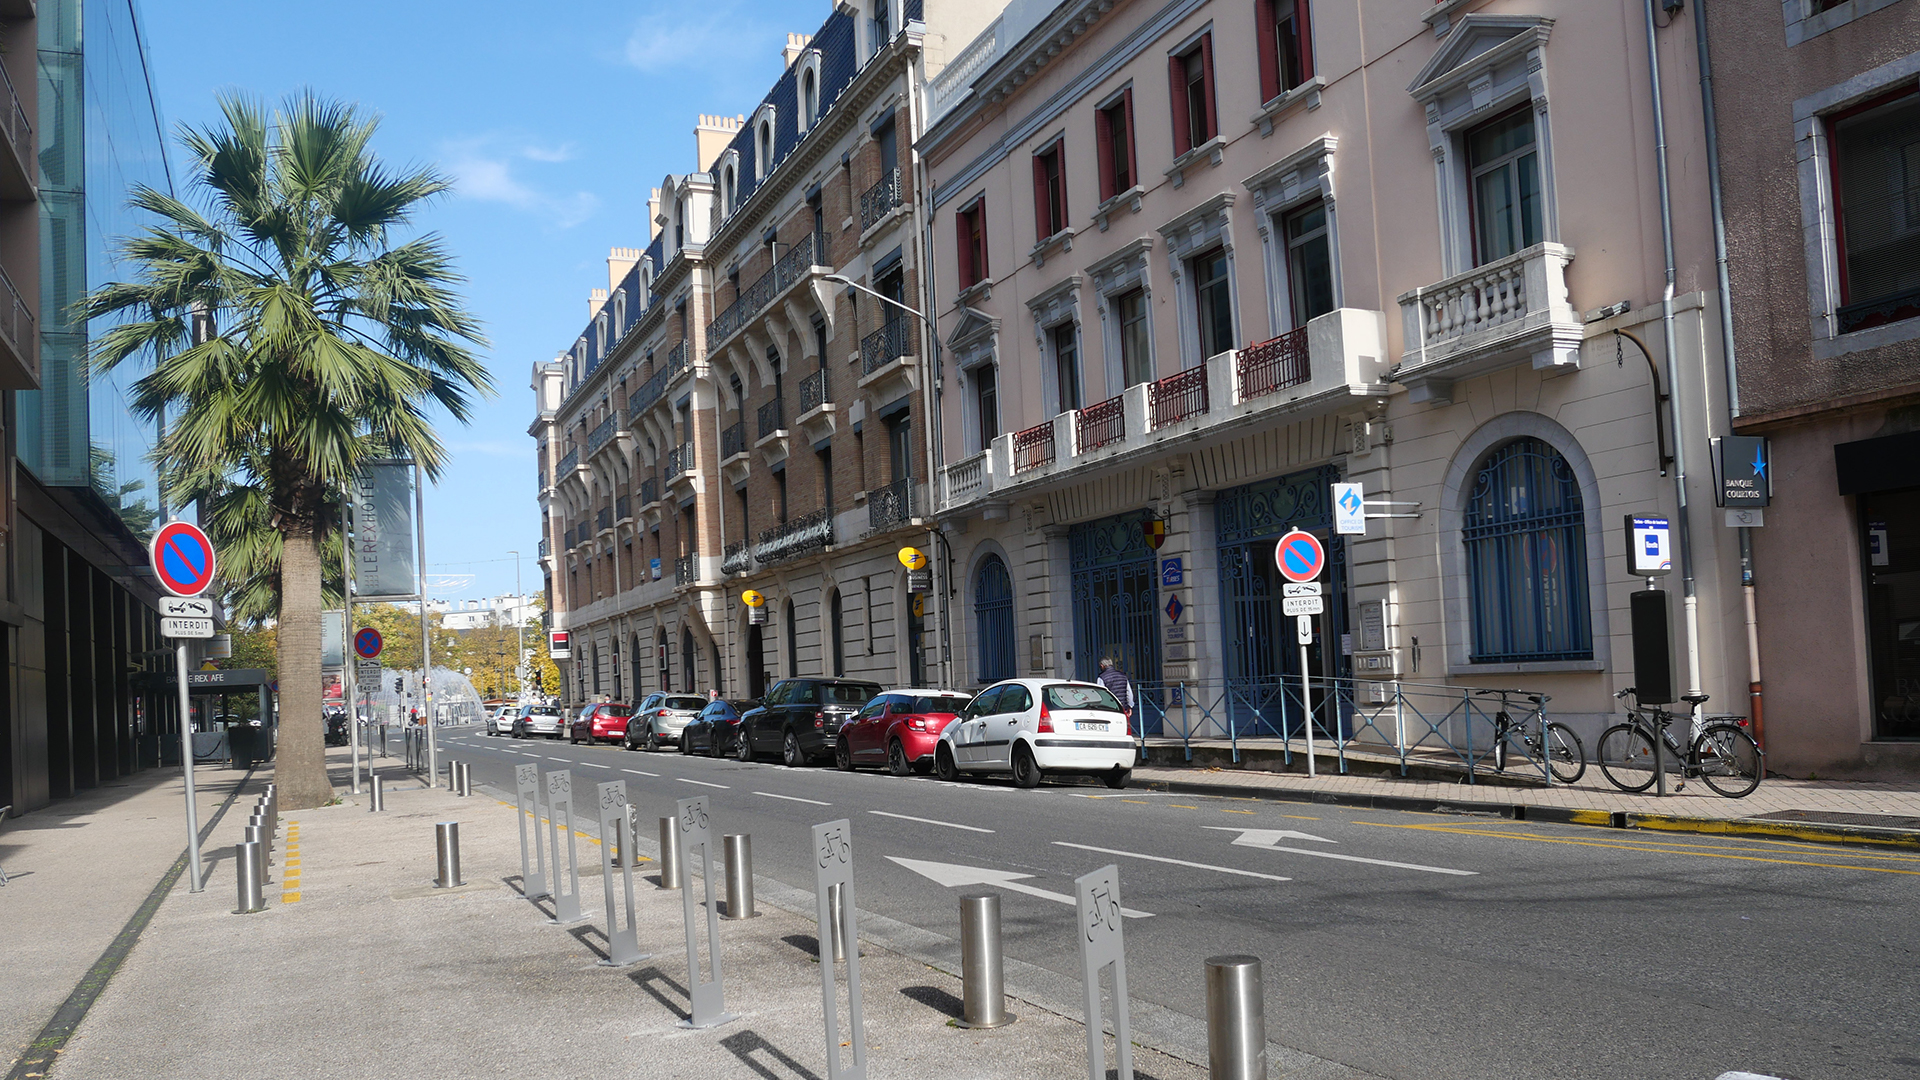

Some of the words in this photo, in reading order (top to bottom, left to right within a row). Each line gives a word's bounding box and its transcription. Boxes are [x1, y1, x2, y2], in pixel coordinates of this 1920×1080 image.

[1726, 480, 1753, 488] BANQUE
[1726, 490, 1760, 498] COURTOIS
[169, 621, 208, 629] INTERDIT
[166, 676, 178, 684] BA
